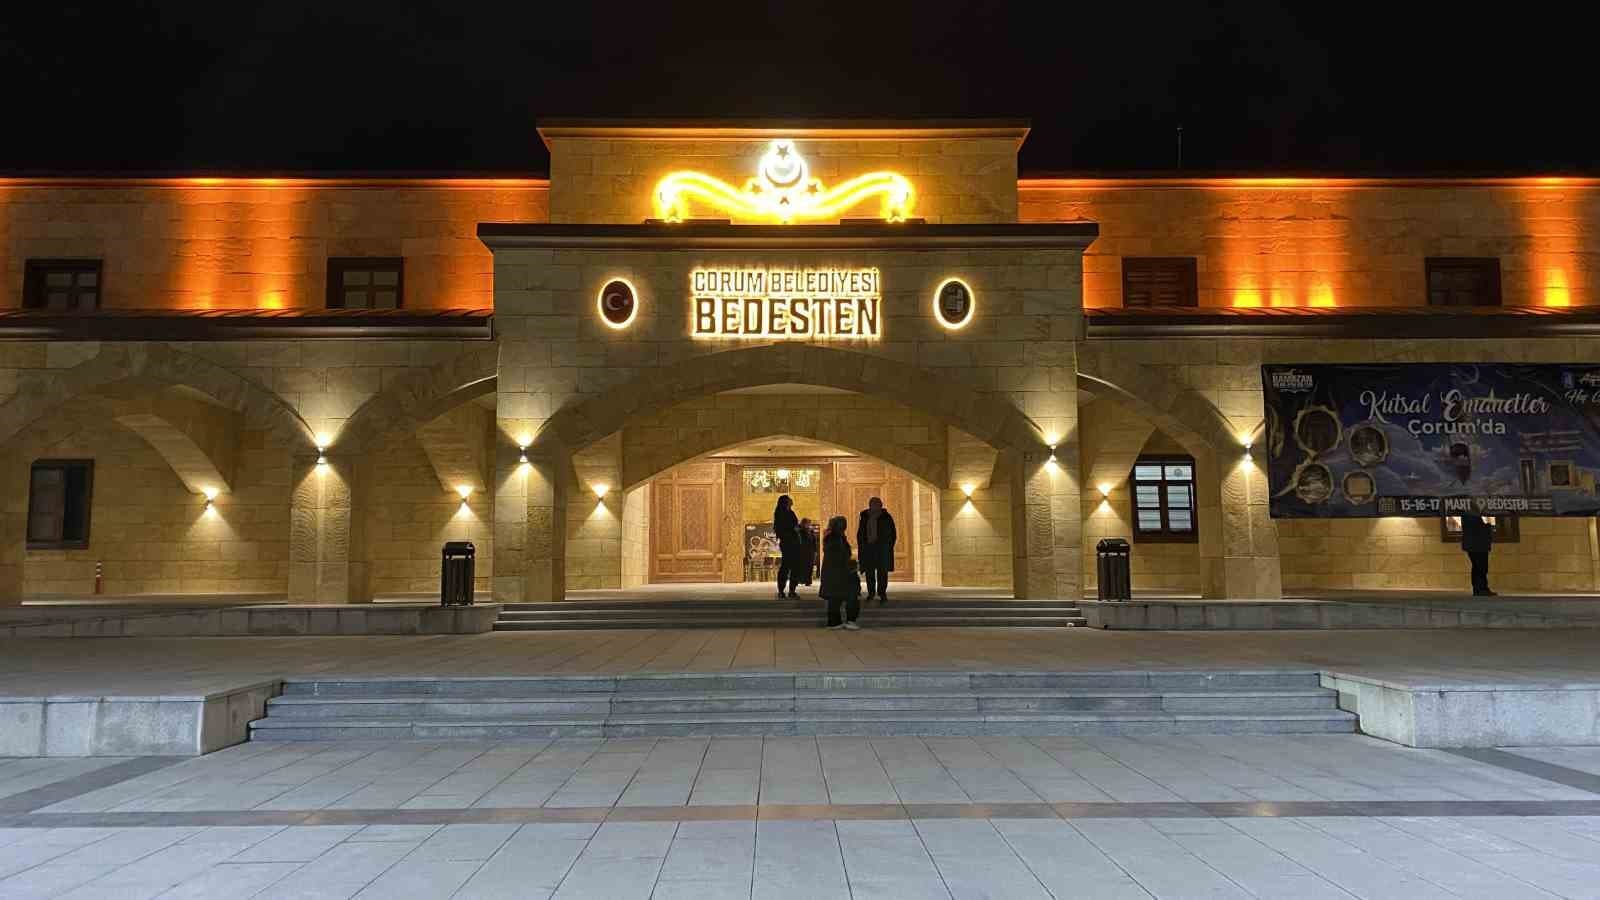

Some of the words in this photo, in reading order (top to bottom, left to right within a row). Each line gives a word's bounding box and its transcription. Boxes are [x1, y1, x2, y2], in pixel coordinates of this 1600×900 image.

[770, 268, 880, 293] BELEDİYESİ
[695, 297, 881, 335] BEDESTEN
[1359, 389, 1431, 424] Kutsal
[1440, 388, 1549, 421] Emanetler
[1407, 419, 1506, 438] Çorum'da
[1400, 498, 1440, 511] 15-16-17
[1445, 498, 1471, 511] MART
[1487, 498, 1529, 511] BEDESTEN
